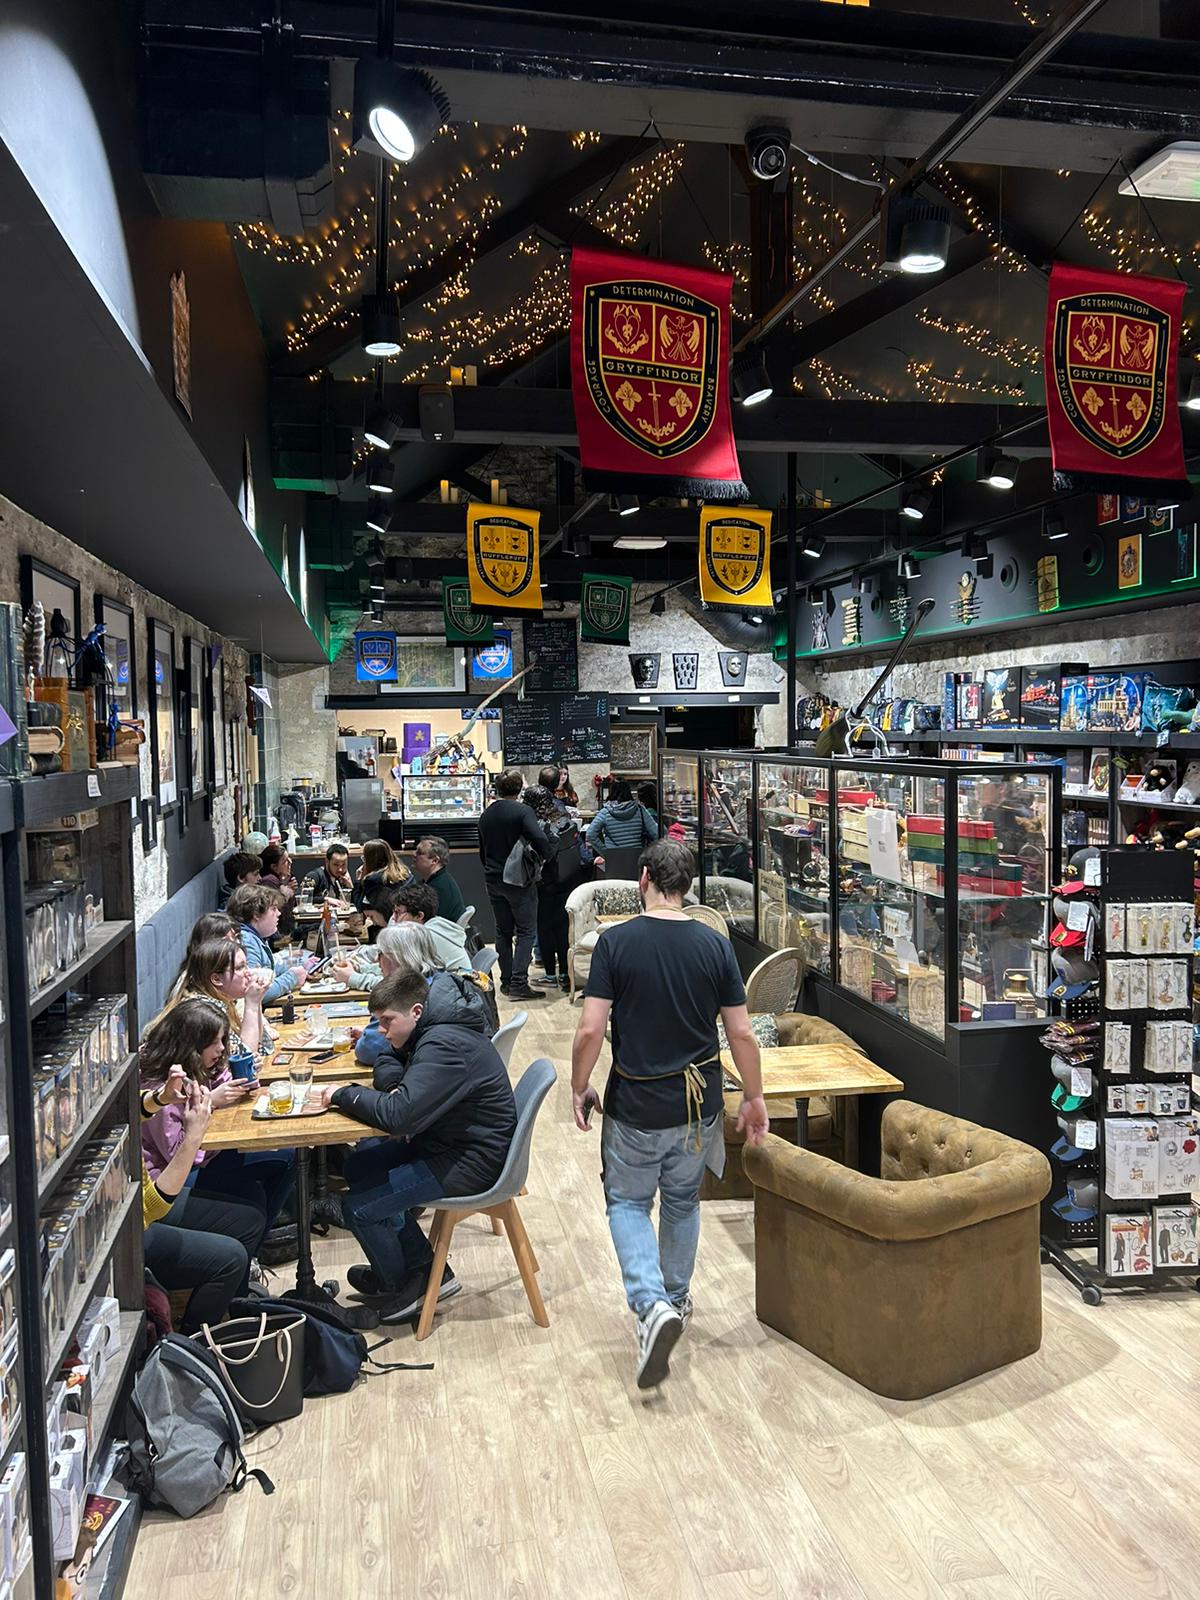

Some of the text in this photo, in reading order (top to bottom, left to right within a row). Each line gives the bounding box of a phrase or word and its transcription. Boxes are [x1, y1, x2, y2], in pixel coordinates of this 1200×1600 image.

[612, 285, 695, 308] DETERMINATION
[1080, 298, 1149, 316] DETERMINATION
[605, 360, 699, 382] GRYFFINDOR
[1072, 368, 1150, 386] GRYFFINDOR
[588, 359, 611, 414] COURAGE
[1057, 368, 1078, 418] COURAGE
[701, 377, 715, 424] BRAVERY
[1152, 380, 1164, 425] BRAVERY
[483, 552, 526, 561] HUFFLEPUFF
[713, 552, 757, 560] HUFFLEPUFF
[62, 817, 76, 827] 110
